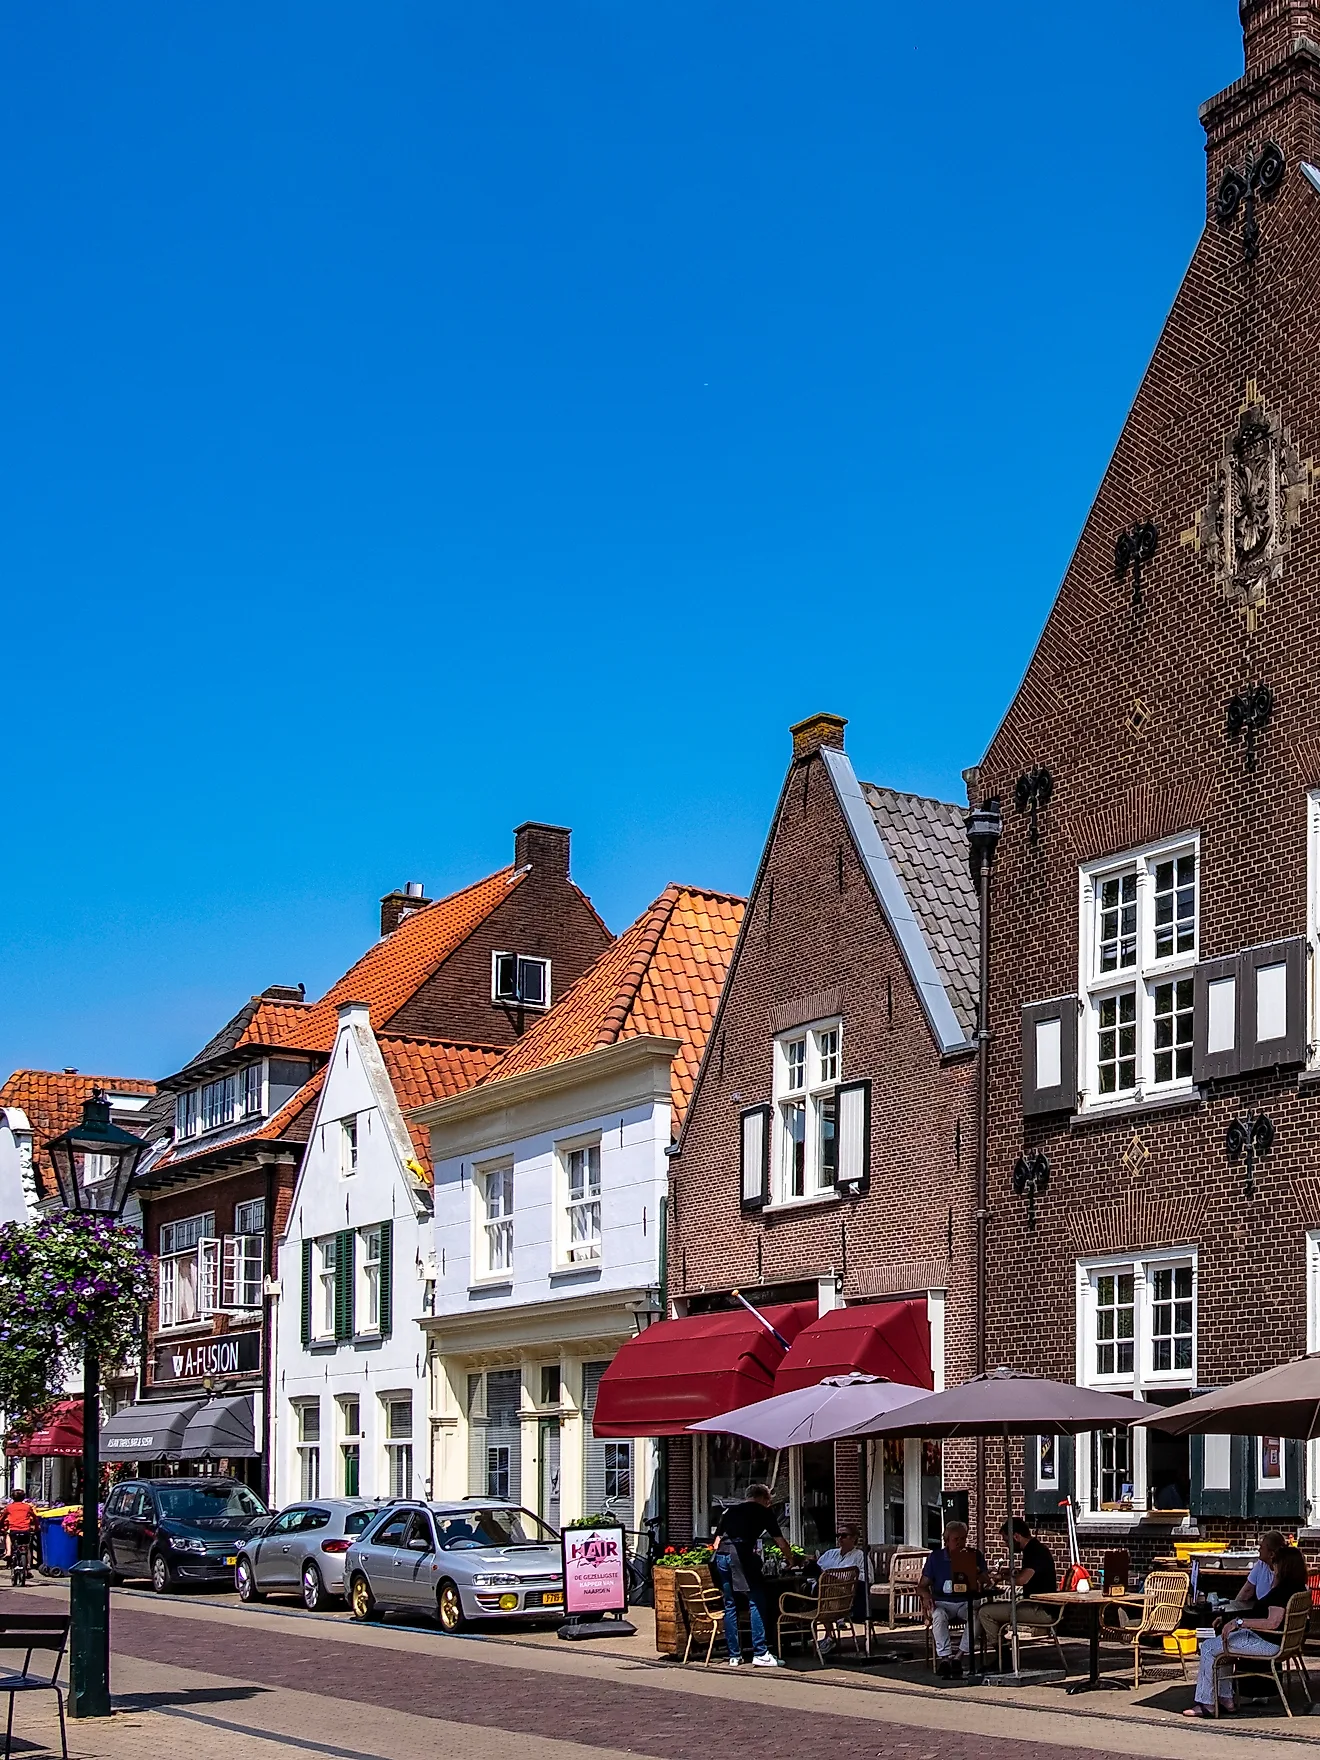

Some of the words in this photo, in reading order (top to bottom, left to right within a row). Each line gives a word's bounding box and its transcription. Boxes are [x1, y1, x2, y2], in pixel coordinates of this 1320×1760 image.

[184, 1341, 239, 1376] A-FUSION
[946, 1499, 954, 1507] 24
[571, 1541, 619, 1559] HAIR
[583, 1572, 618, 1580] GEZELLIGSTE
[603, 1579, 614, 1587] VAN
